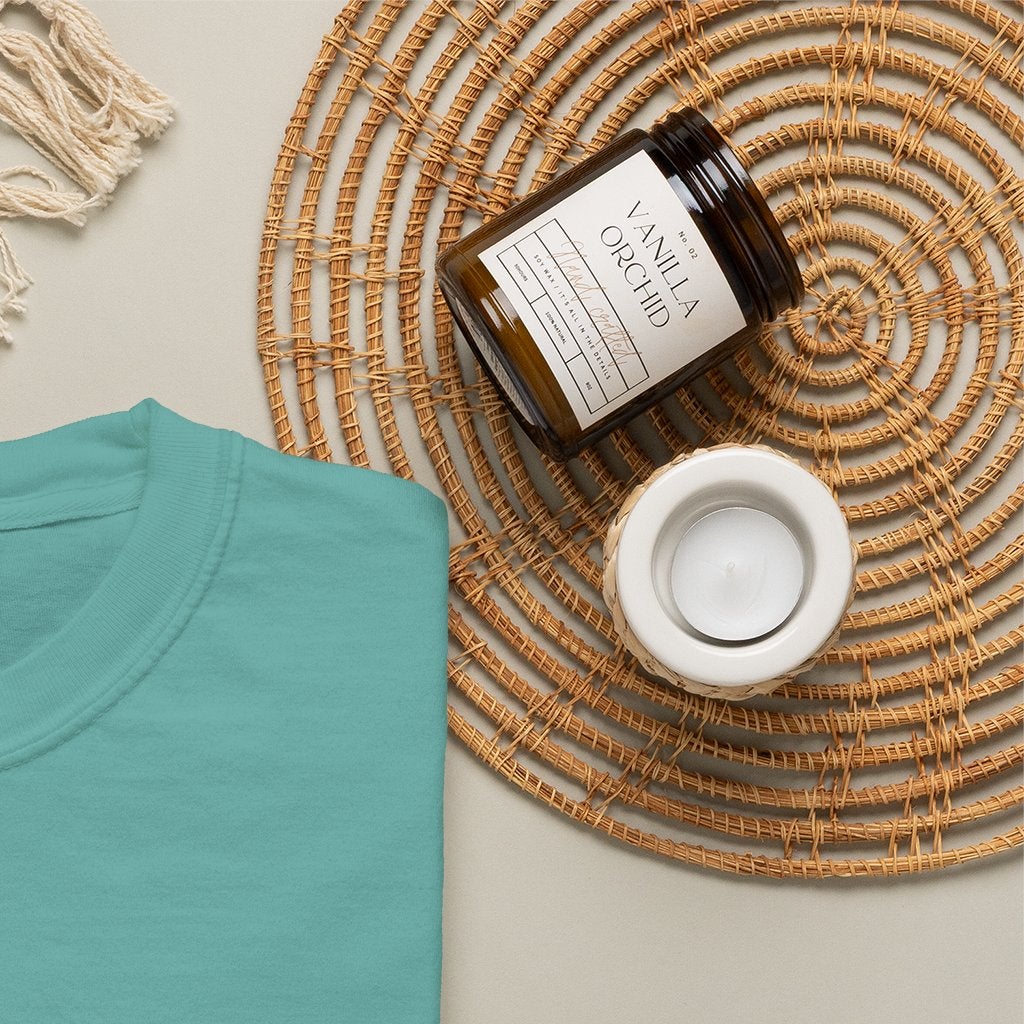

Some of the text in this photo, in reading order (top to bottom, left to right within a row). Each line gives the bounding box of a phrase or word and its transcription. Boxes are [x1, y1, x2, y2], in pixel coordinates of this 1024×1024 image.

[599, 224, 671, 329] ORCHID
[625, 199, 701, 320] VANILLA
[687, 246, 699, 260] 02
[532, 253, 545, 267] SOY
[542, 268, 555, 284] WAX
[567, 308, 579, 323] ALL
[577, 323, 586, 335] IN
[584, 334, 596, 350] THE
[592, 350, 612, 381] DETAILS
[552, 322, 567, 346] NATURAL
